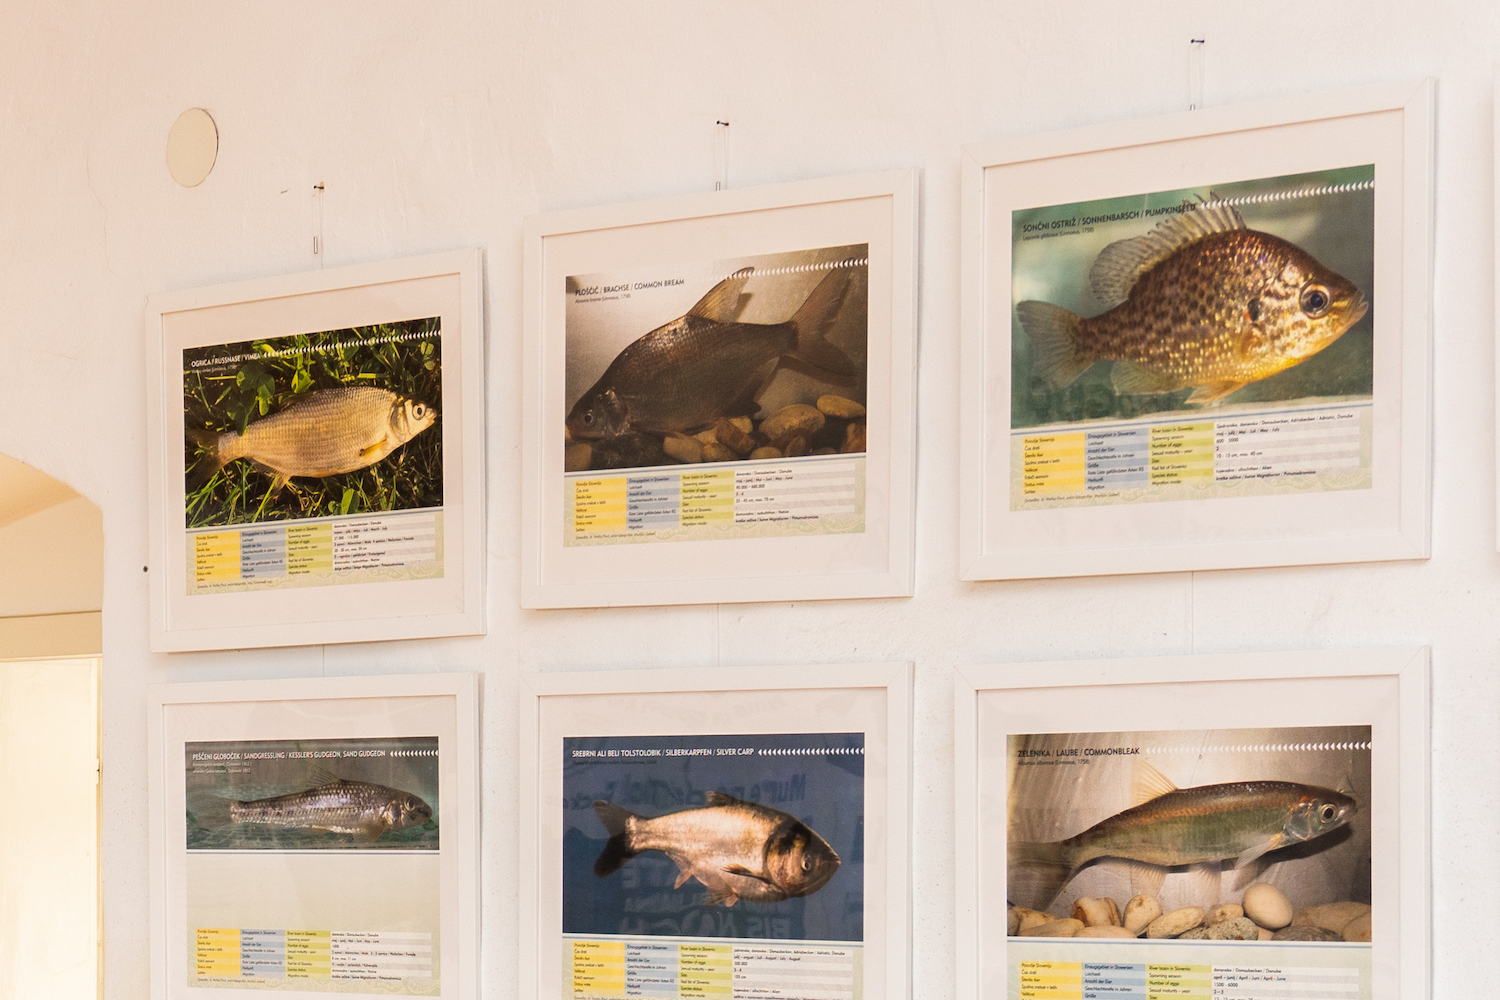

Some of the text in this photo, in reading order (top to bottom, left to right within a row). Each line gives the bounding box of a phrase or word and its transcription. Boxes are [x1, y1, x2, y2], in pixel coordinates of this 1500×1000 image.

[1082, 211, 1139, 225] SONNENBARSCH
[604, 284, 629, 293] BRACHSE
[634, 281, 663, 290] COMMON
[664, 279, 684, 287] BREAM
[572, 750, 596, 758] SREBRNI
[717, 748, 736, 756] SILVER
[1018, 749, 1050, 758] ZELENIKA
